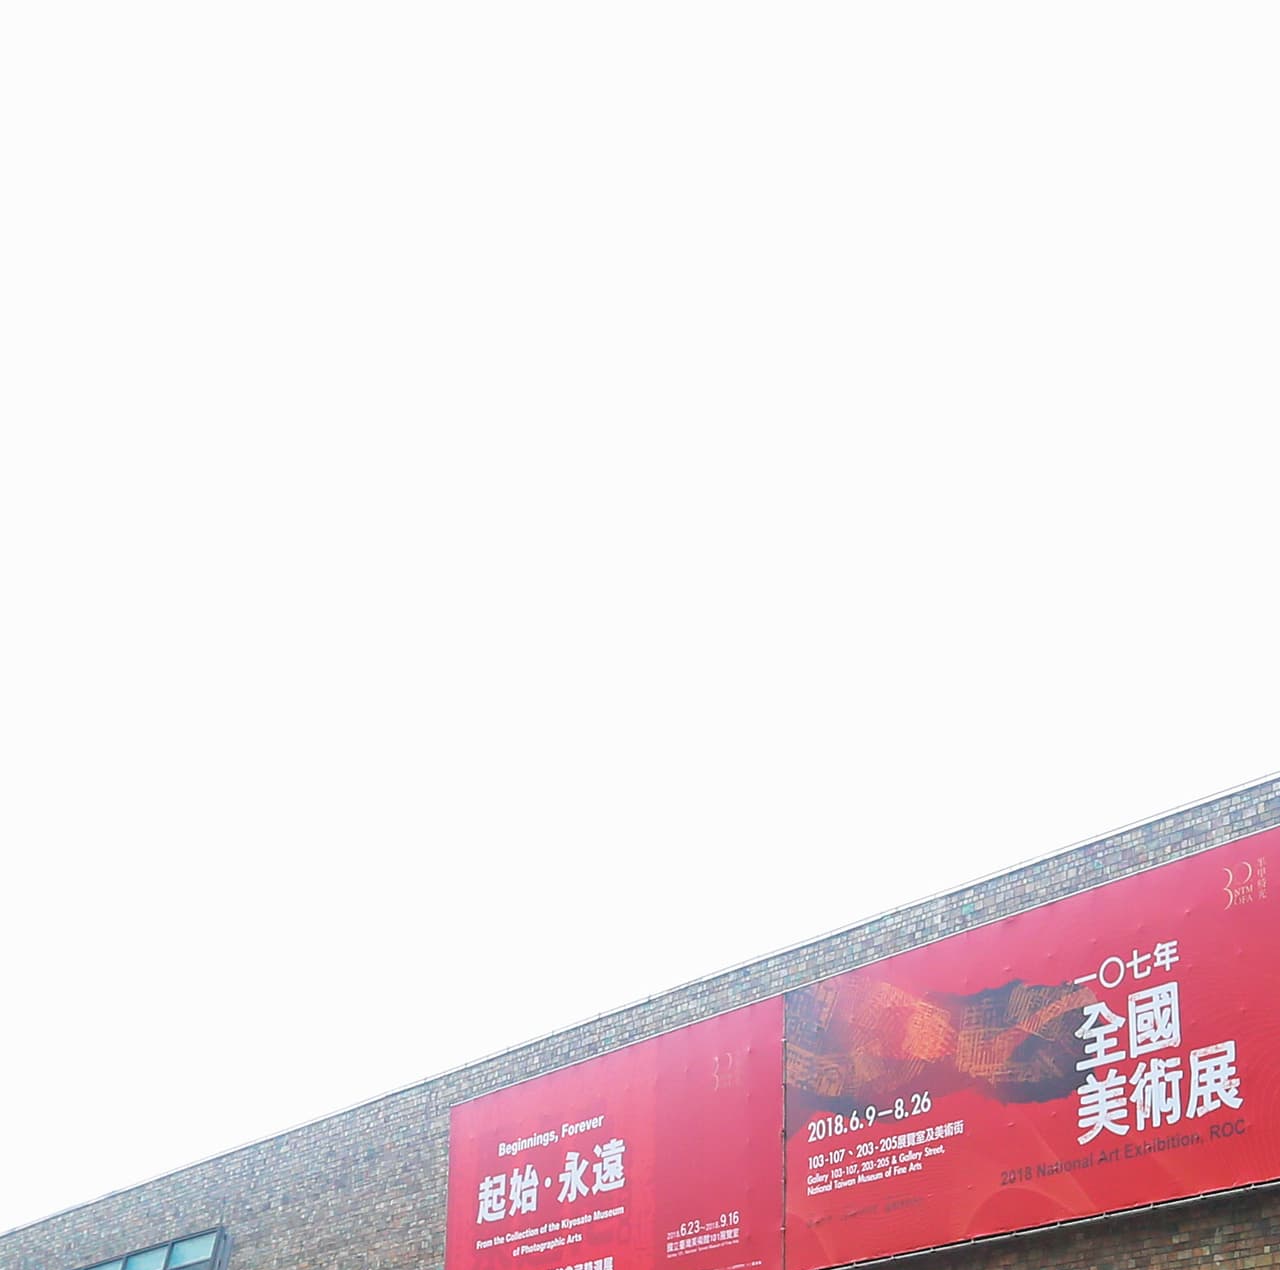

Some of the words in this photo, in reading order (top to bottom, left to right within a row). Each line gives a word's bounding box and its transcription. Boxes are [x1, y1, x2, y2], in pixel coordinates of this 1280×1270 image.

[1074, 981, 1182, 1072] 全國
[1077, 1040, 1244, 1145] 美術展
[498, 1129, 559, 1156] Beginnings,
[561, 1115, 605, 1138] Forever
[1000, 1166, 1033, 1186] 2018
[1036, 1154, 1094, 1177] National
[1097, 1148, 1120, 1169] Art
[1124, 1133, 1205, 1159] Exhibition,
[1209, 1119, 1247, 1141] ROC
[807, 1172, 829, 1185] Gallery
[861, 1157, 890, 1172] 203-205
[891, 1155, 897, 1164] &
[899, 1149, 923, 1163] Gallery
[807, 1183, 832, 1196] National
[834, 1177, 856, 1190] Taiwan
[857, 1171, 883, 1184] Museum
[885, 1168, 892, 1178] of
[893, 1165, 907, 1176] Fine
[908, 1162, 923, 1172] Arts
[476, 1238, 493, 1250] From
[493, 1235, 505, 1246] the
[505, 1227, 539, 1243] Collection
[539, 1223, 548, 1234] of
[548, 1221, 560, 1232] the
[561, 1213, 592, 1230] Kiyosato
[593, 1206, 625, 1221] Museum
[512, 1245, 520, 1256] of
[521, 1236, 566, 1256] Photographic
[566, 1233, 583, 1245] Arts
